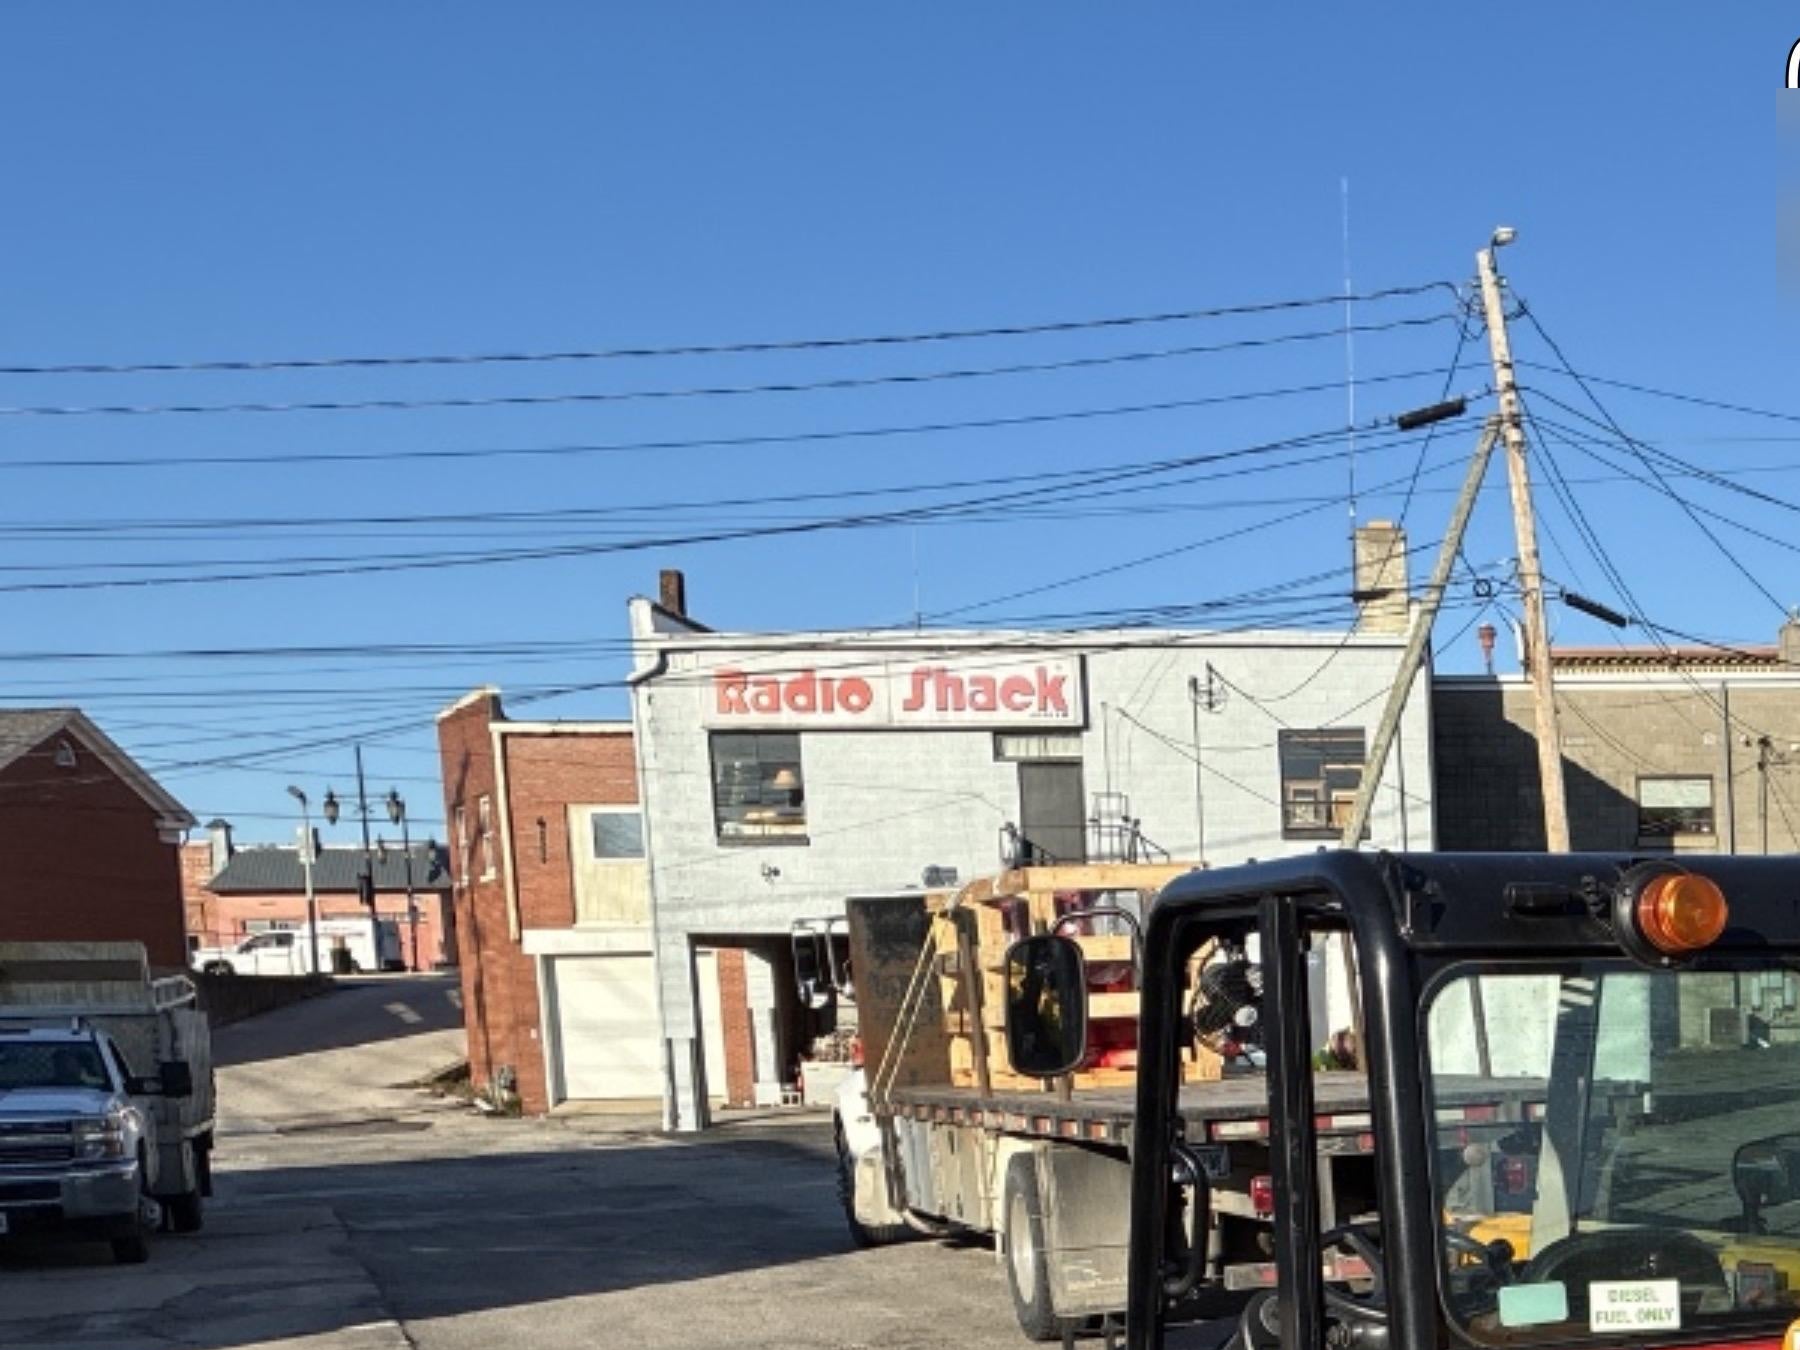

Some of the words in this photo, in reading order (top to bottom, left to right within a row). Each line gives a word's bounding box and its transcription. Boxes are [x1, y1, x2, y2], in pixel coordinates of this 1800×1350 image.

[714, 666, 873, 714] Radio
[902, 664, 1069, 712] Shack
[1607, 1288, 1660, 1303] DIESEL
[1596, 1310, 1632, 1324] FUEL
[1635, 1306, 1675, 1323] ONLY
